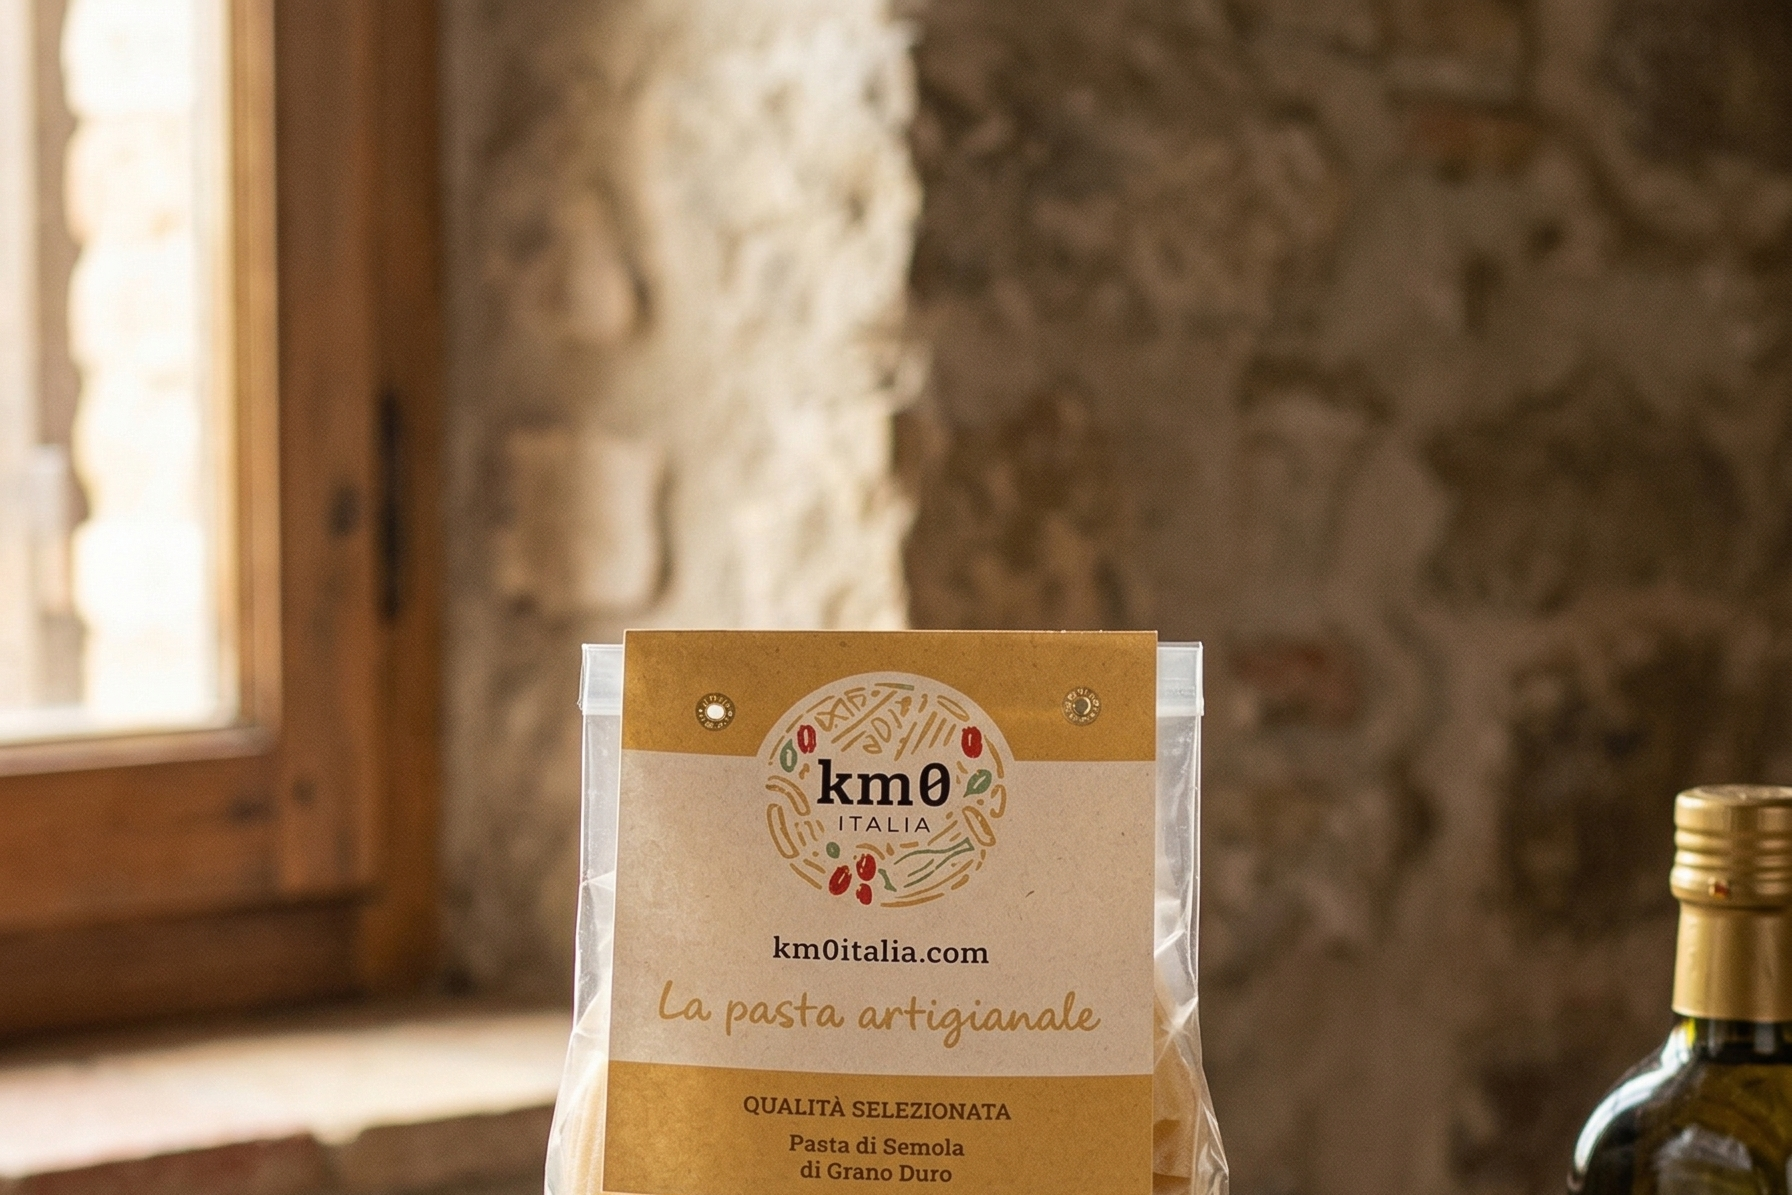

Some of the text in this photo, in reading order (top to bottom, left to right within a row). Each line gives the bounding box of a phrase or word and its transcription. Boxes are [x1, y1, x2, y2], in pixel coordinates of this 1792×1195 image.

[817, 758, 950, 807] km0
[838, 815, 931, 833] ITALIA
[773, 935, 990, 965] km0italia.com
[658, 980, 1101, 1049] La pasta artigianale
[743, 1094, 1012, 1121] QUALITÀ SELEZIONATA
[789, 1134, 965, 1157] Pasta di Semola
[800, 1160, 952, 1183] di Grano Duro
